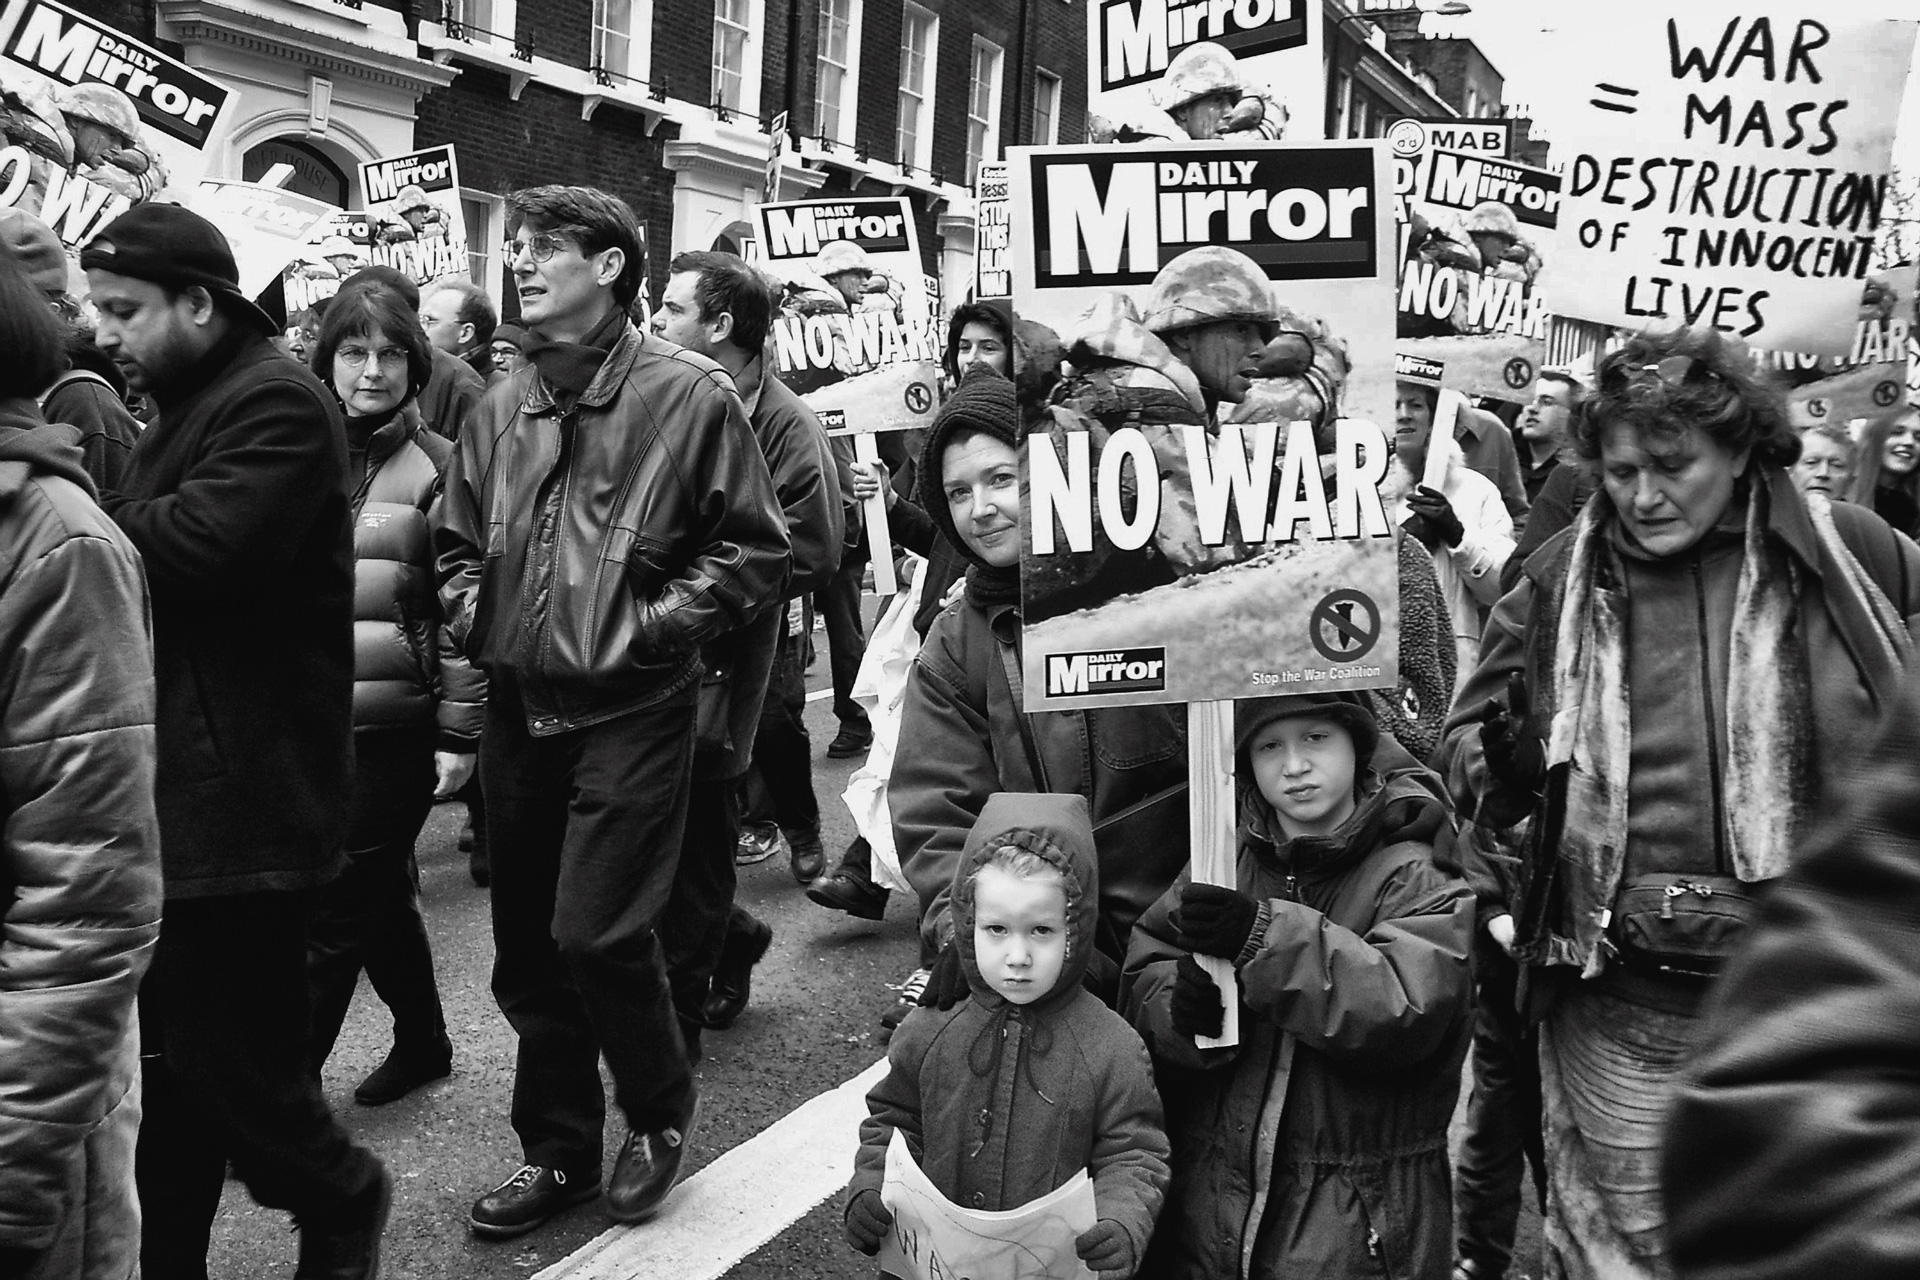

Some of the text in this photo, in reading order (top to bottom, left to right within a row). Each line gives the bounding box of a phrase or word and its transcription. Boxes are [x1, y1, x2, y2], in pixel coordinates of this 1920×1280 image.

[12, 3, 217, 127] Mirror
[98, 35, 161, 72] DAILY
[1667, 16, 1830, 84] WAR
[1431, 131, 1501, 150] MAB
[1684, 93, 1849, 155] MASS
[0, 145, 31, 207] O
[366, 160, 449, 202] Mirror
[394, 157, 419, 170] DAILY
[1159, 160, 1259, 187] DAILY
[1431, 153, 1561, 213] Mirror
[1482, 163, 1523, 181] DAILY
[814, 205, 855, 218] DAILY
[1570, 154, 1888, 232] DESTRUCTION
[767, 206, 903, 256] Mirror
[1046, 161, 1368, 276] Mirror
[372, 236, 469, 280] NO WAR
[1579, 219, 1876, 279] OF INNOCENT
[1399, 260, 1547, 340] NO WAR
[1625, 276, 1770, 338] LIVES
[773, 309, 934, 372] NO WAR
[818, 414, 845, 426] ror
[1028, 418, 1392, 555] NO WAR
[1049, 655, 1163, 694] Mirror
[1089, 653, 1124, 663] DAILY
[1252, 664, 1380, 686] Stop the War Coalition
